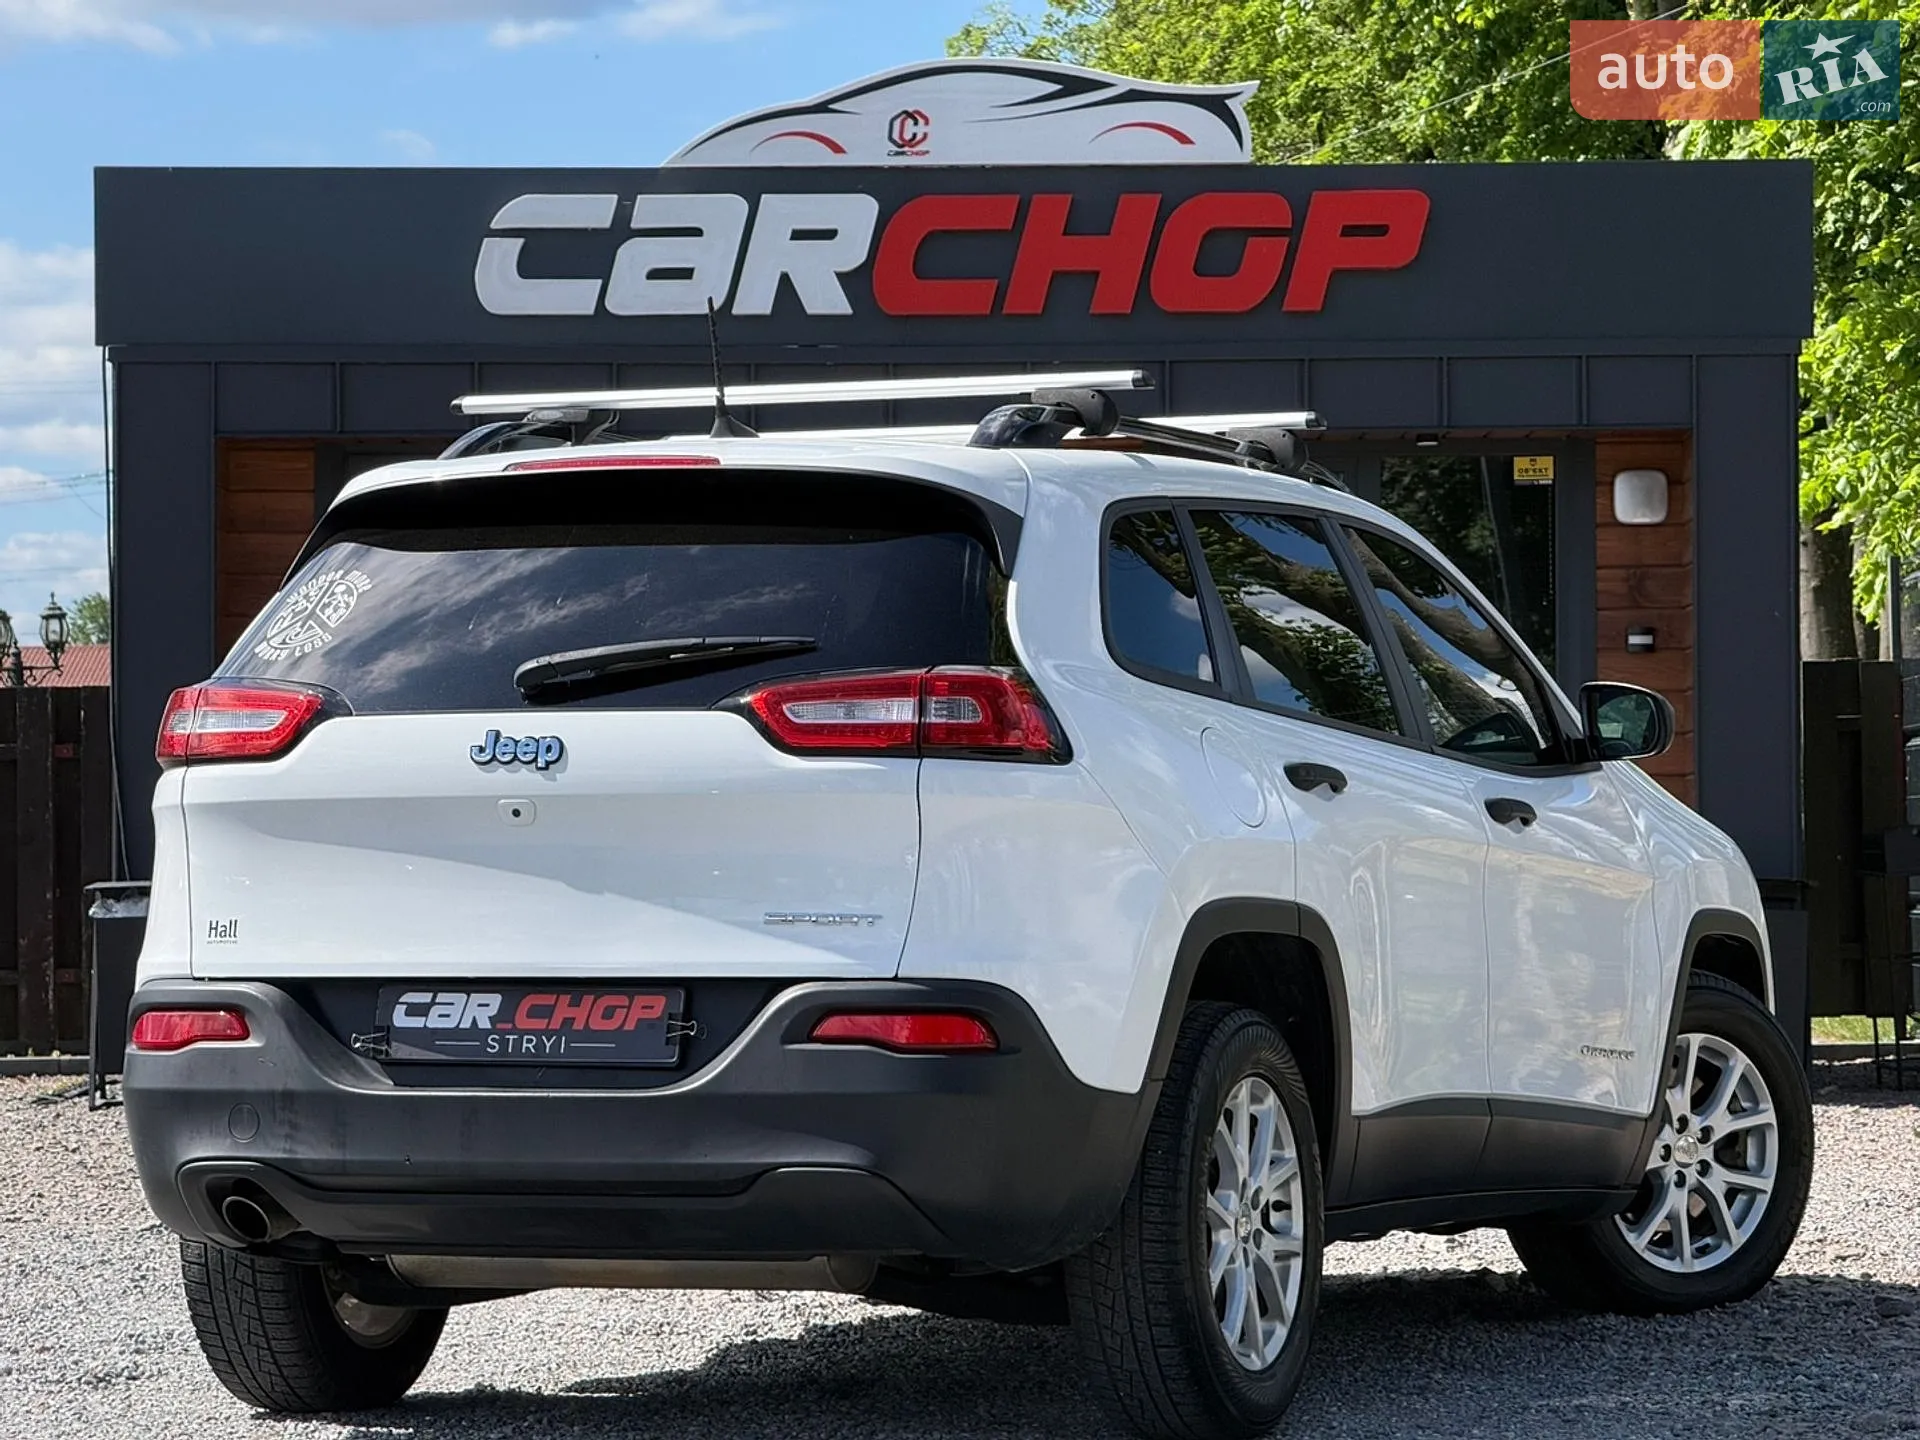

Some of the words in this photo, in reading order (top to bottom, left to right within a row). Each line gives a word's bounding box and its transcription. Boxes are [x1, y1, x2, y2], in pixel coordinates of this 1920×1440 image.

[470, 729, 564, 771] Jeep
[207, 918, 238, 938] Hall
[486, 1034, 566, 1054] STRYI
